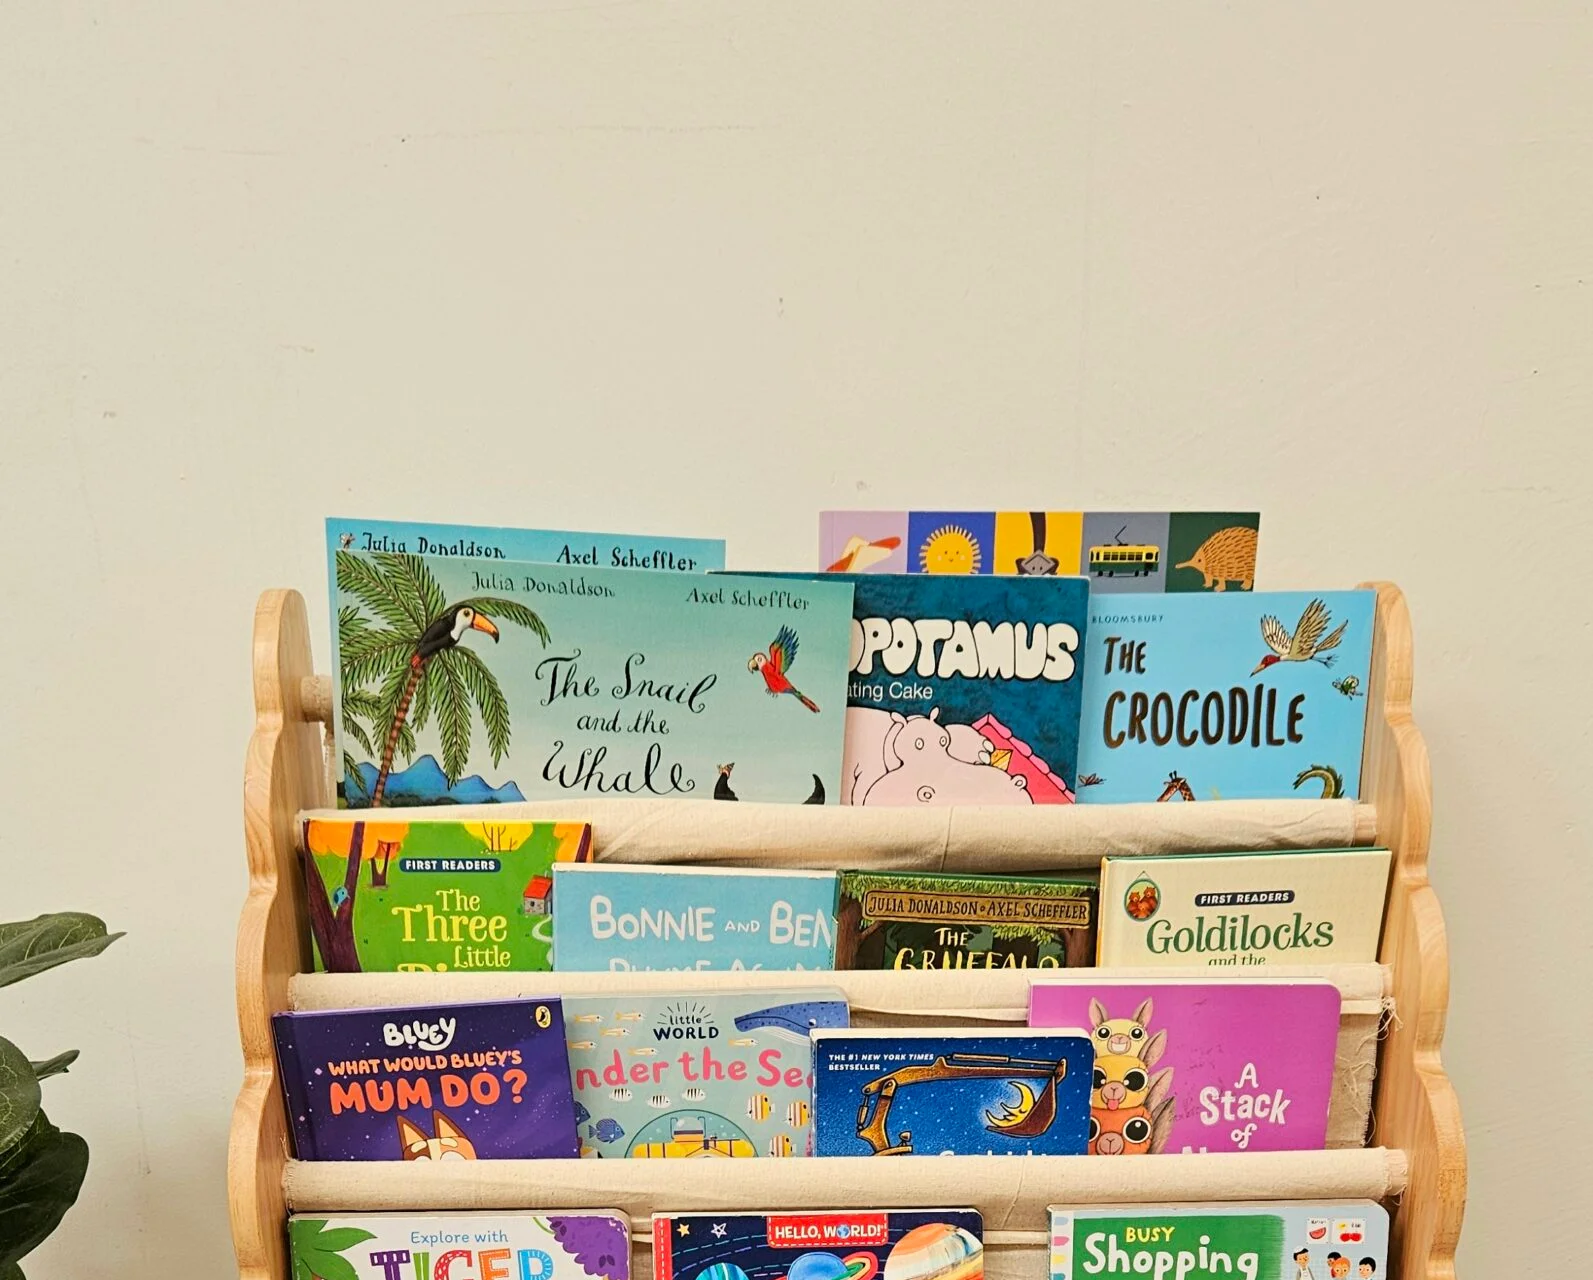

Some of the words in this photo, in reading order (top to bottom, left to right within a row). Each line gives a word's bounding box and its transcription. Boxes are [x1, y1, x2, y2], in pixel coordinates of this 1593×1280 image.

[361, 532, 407, 553] Julia
[417, 537, 506, 559] Donaldson
[557, 544, 599, 566] Axel
[611, 546, 697, 571] Scheffler
[472, 571, 514, 592] Julia
[522, 576, 616, 598] Donaldson
[686, 588, 725, 604] Axel
[731, 589, 810, 611] Scheffler
[1091, 614, 1164, 624] BLOOMSBURY
[1104, 636, 1147, 675] THE
[535, 648, 600, 707] The
[611, 652, 717, 714] Snail
[889, 681, 933, 700] Cake
[576, 708, 621, 733] and
[627, 708, 670, 735] the
[1103, 683, 1306, 749] CROCODILE
[542, 740, 696, 796] Whale
[405, 860, 438, 870] FIRST
[442, 860, 496, 870] READERS
[435, 888, 481, 912] The
[868, 896, 904, 913] JULIA
[907, 897, 978, 915] DONALDSON
[986, 901, 1020, 917] AXEL
[1023, 902, 1087, 919] SCHEFFLER
[1200, 894, 1233, 905] FIRST
[1236, 892, 1290, 903] READERS
[391, 904, 508, 942] Three
[590, 895, 716, 942] BONNIE
[724, 920, 761, 933] AND
[769, 900, 832, 949] BEN
[1146, 912, 1334, 954] Goldilocks
[934, 927, 969, 947] THE
[454, 945, 511, 969] Little
[1208, 953, 1237, 966] and
[1241, 953, 1266, 966] the
[669, 1014, 702, 1025] little
[382, 1017, 457, 1051] BLUEY
[653, 1026, 719, 1041] WORLD
[328, 1059, 380, 1076] WHAT
[383, 1055, 447, 1074] WOULD
[451, 1050, 522, 1069] BLUEY'S
[576, 1049, 669, 1090] nder
[677, 1046, 748, 1083] the
[1234, 1062, 1259, 1088] A
[330, 1077, 433, 1115] MUM
[440, 1069, 528, 1109] DO?
[1199, 1086, 1291, 1125] Stack
[1231, 1123, 1258, 1149] of
[411, 1230, 469, 1247] Explore
[475, 1230, 509, 1243] with
[775, 1225, 822, 1239] HELLO,
[1126, 1226, 1175, 1243] BUSY
